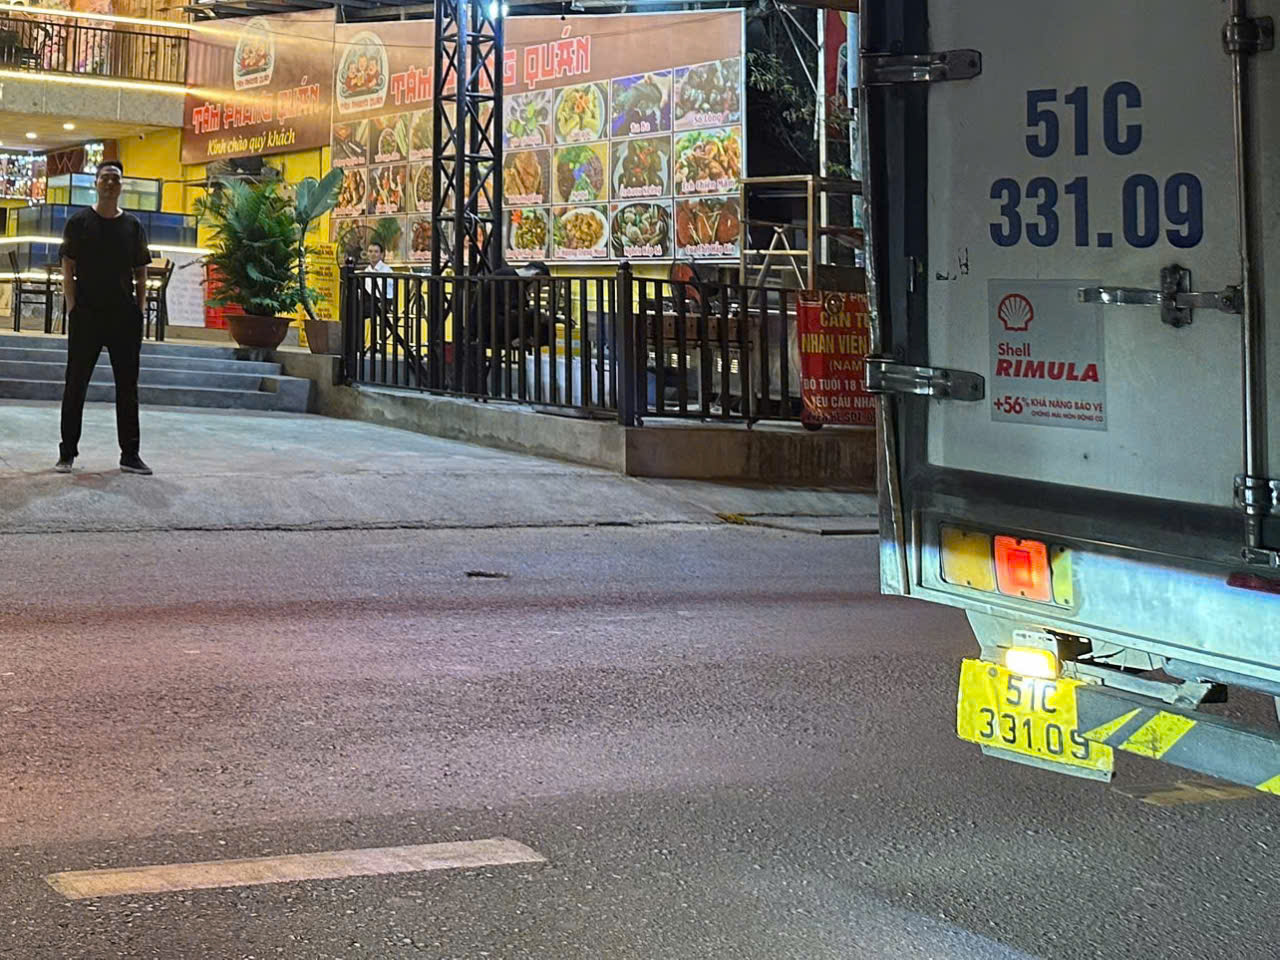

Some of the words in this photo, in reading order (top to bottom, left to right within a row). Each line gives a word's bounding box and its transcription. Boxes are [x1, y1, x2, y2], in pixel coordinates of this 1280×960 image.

[524, 25, 591, 90] QUÁN
[276, 76, 321, 126] QUÁN
[1025, 81, 1143, 159] 51C
[228, 133, 249, 153] chào
[249, 131, 267, 153] quý
[267, 127, 296, 149] khách
[988, 172, 1204, 249] 331.09
[995, 358, 1100, 382] RIMULA
[997, 343, 1031, 357] Shell
[844, 379, 856, 391] 18
[1006, 674, 1057, 714] 51C
